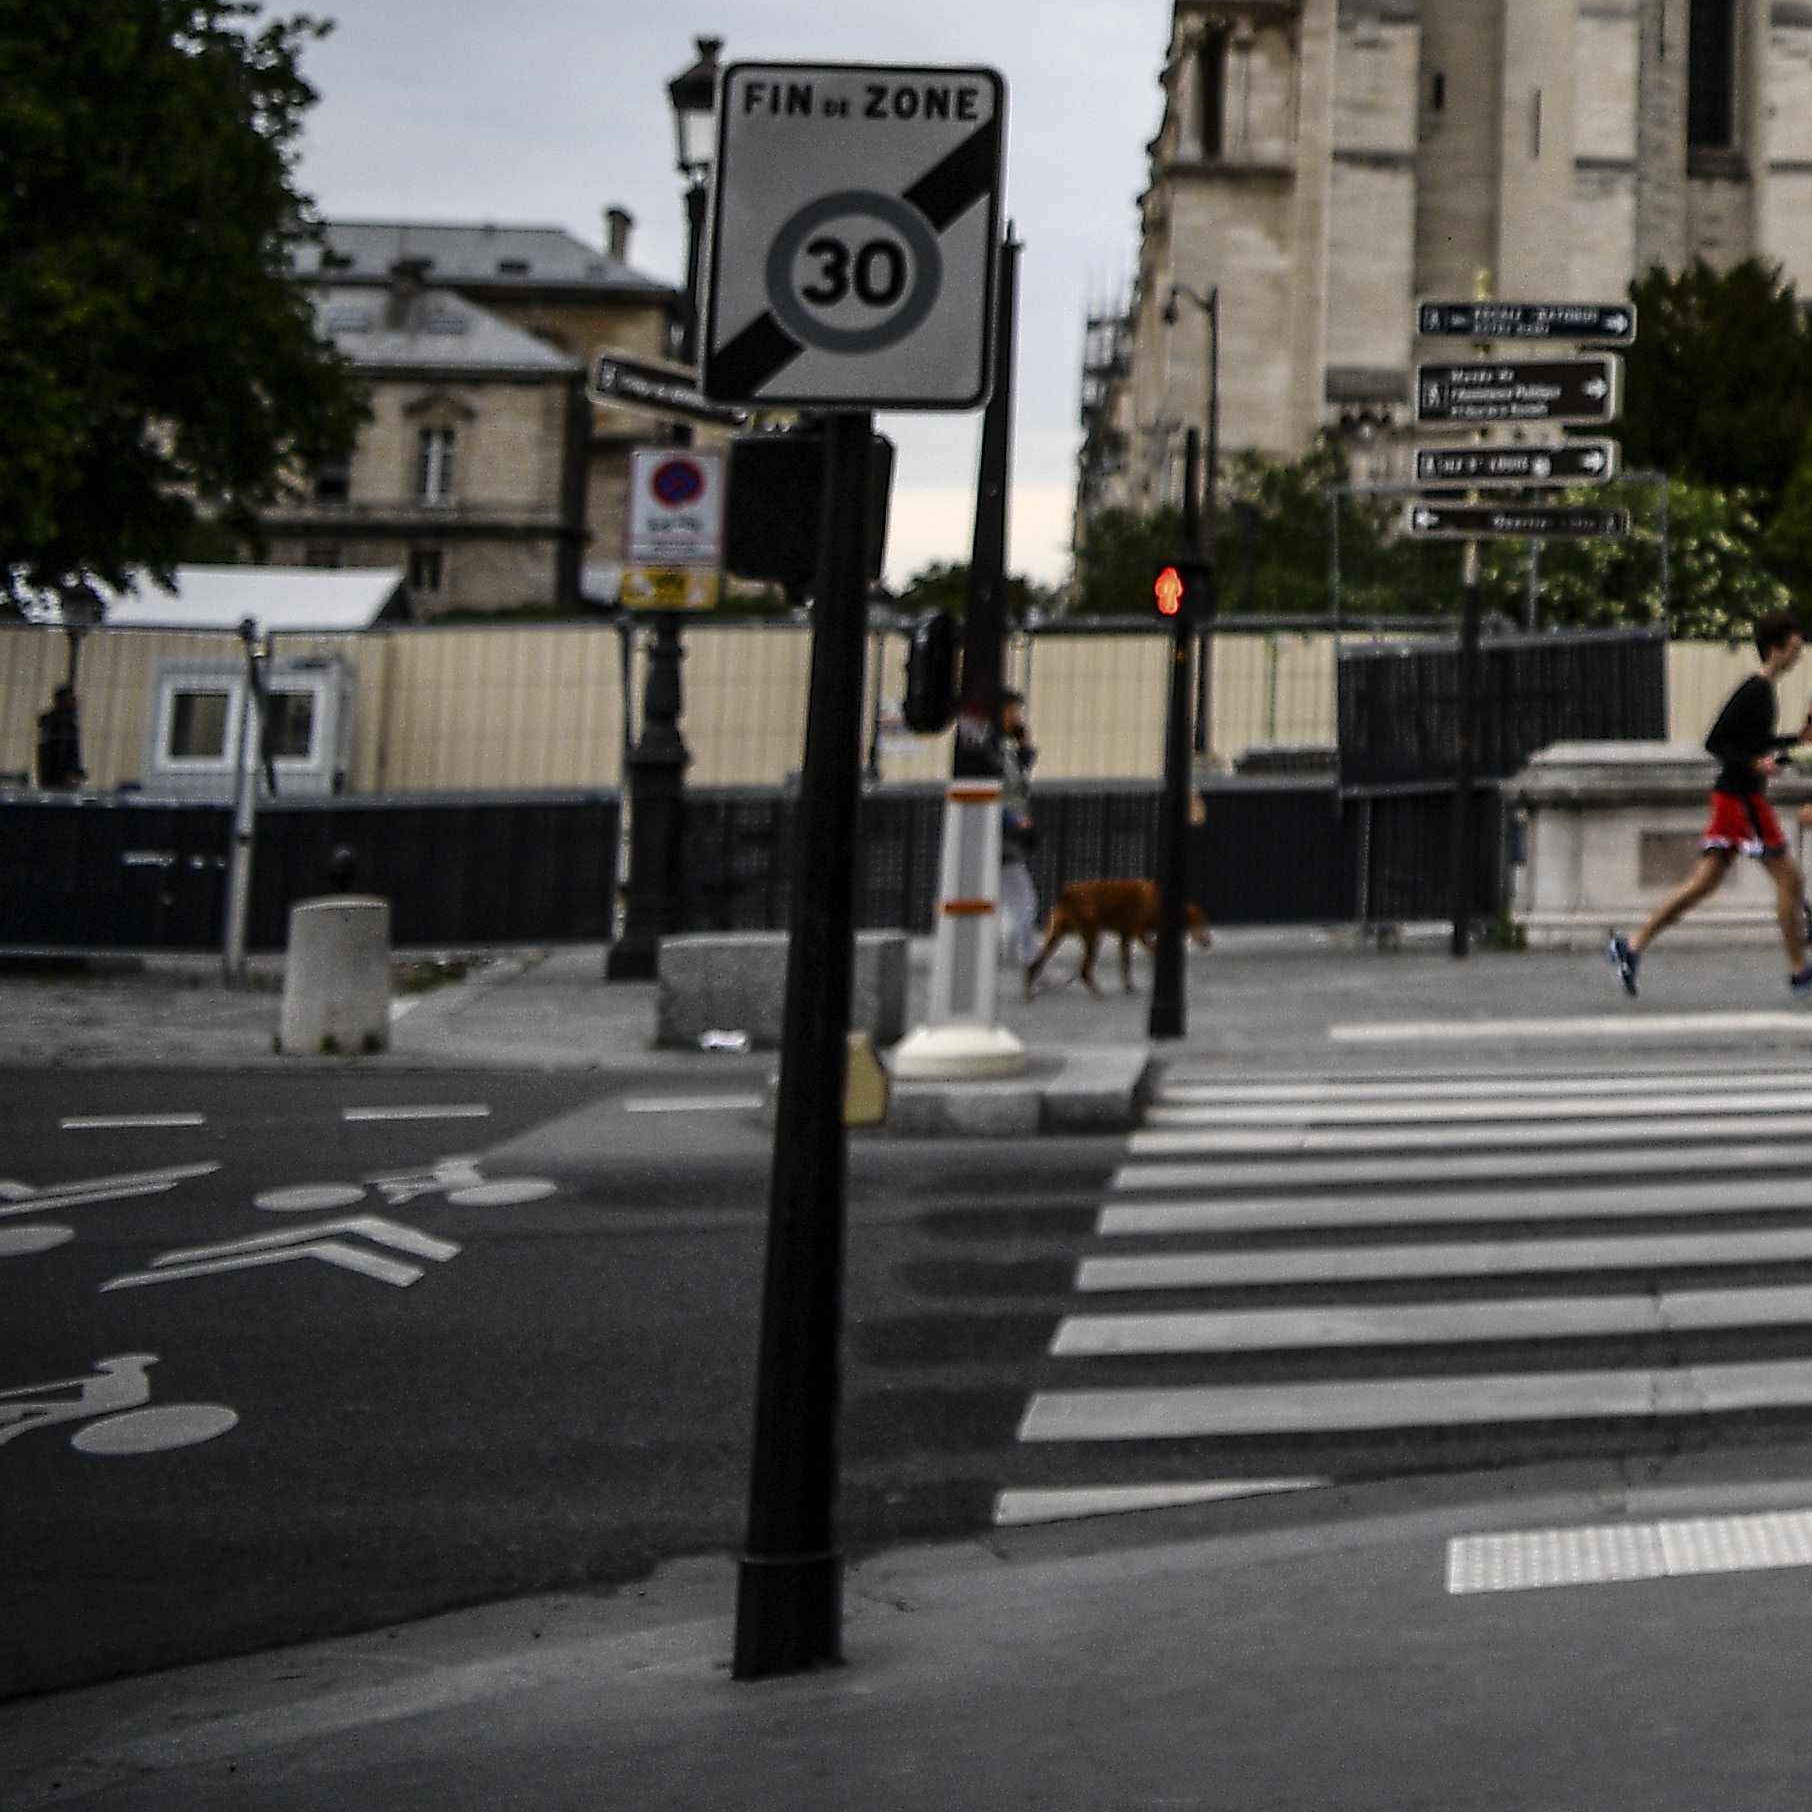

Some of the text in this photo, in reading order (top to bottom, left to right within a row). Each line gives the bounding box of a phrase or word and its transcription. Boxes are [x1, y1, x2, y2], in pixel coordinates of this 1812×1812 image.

[744, 83, 814, 117] FIN
[864, 84, 980, 121] ZONE
[802, 238, 908, 307] 30
